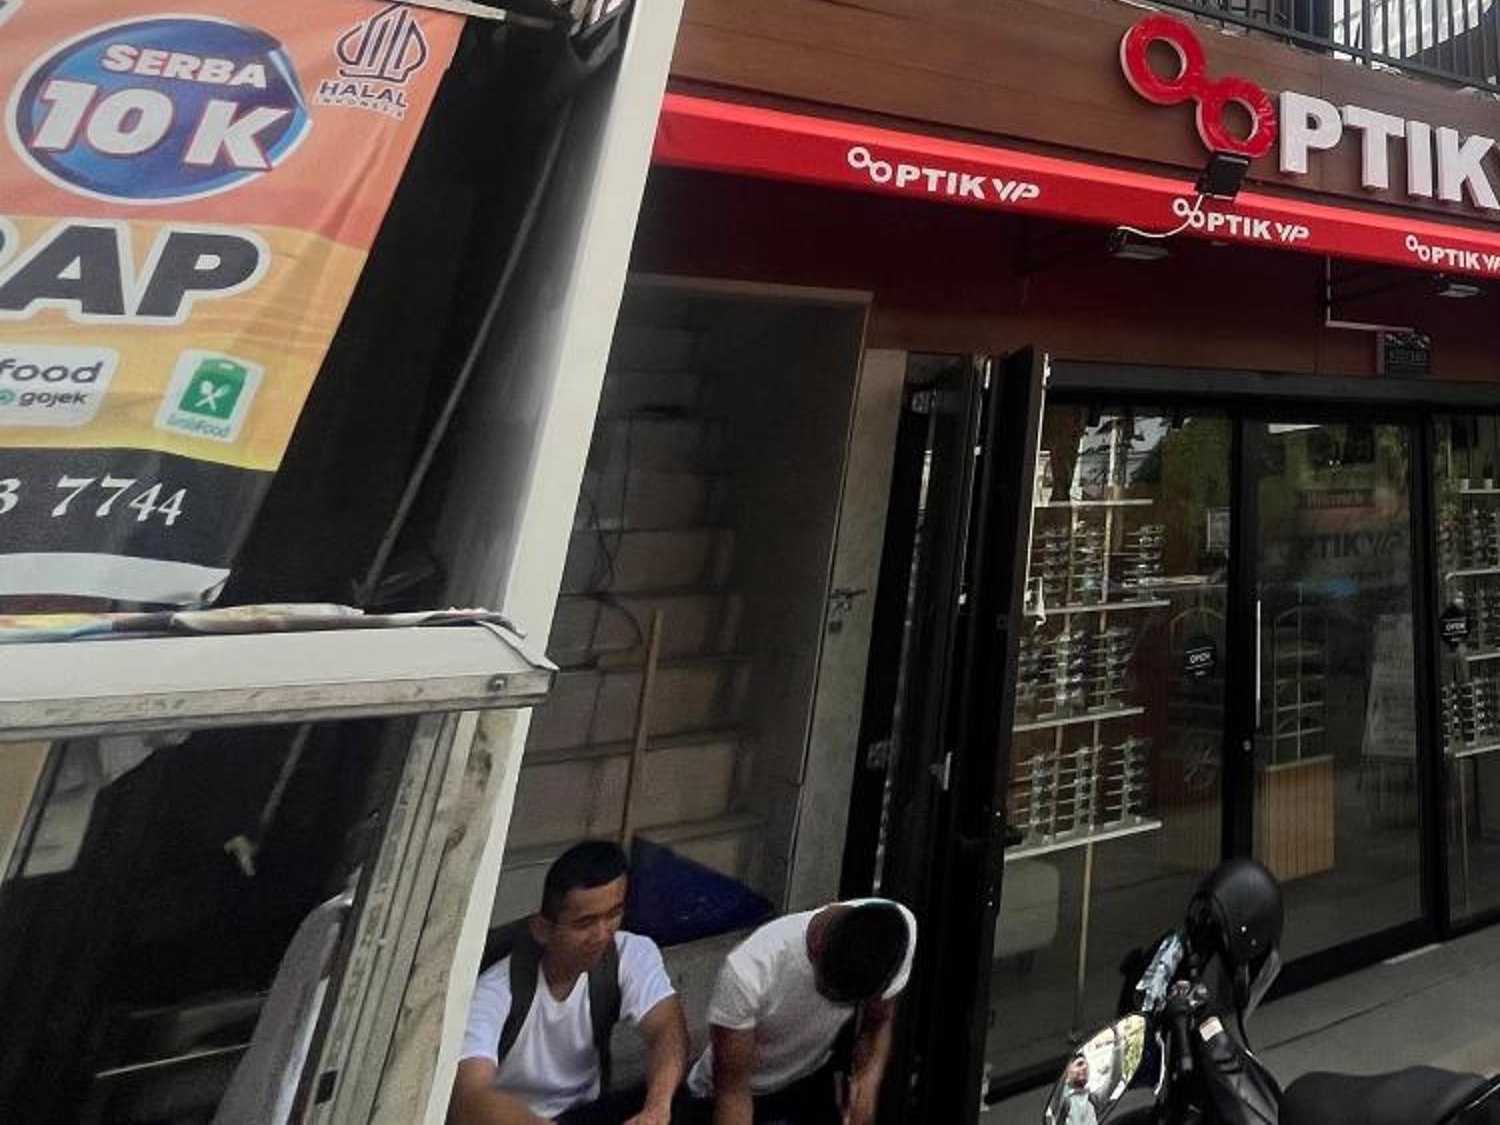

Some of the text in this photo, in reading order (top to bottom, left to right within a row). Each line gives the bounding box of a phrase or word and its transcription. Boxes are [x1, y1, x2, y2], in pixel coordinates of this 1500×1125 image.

[102, 44, 267, 89] SERBA
[320, 81, 408, 108] HALAL
[0, 224, 260, 318] AP
[19, 390, 88, 408] gojek
[51, 473, 189, 526] 7744
